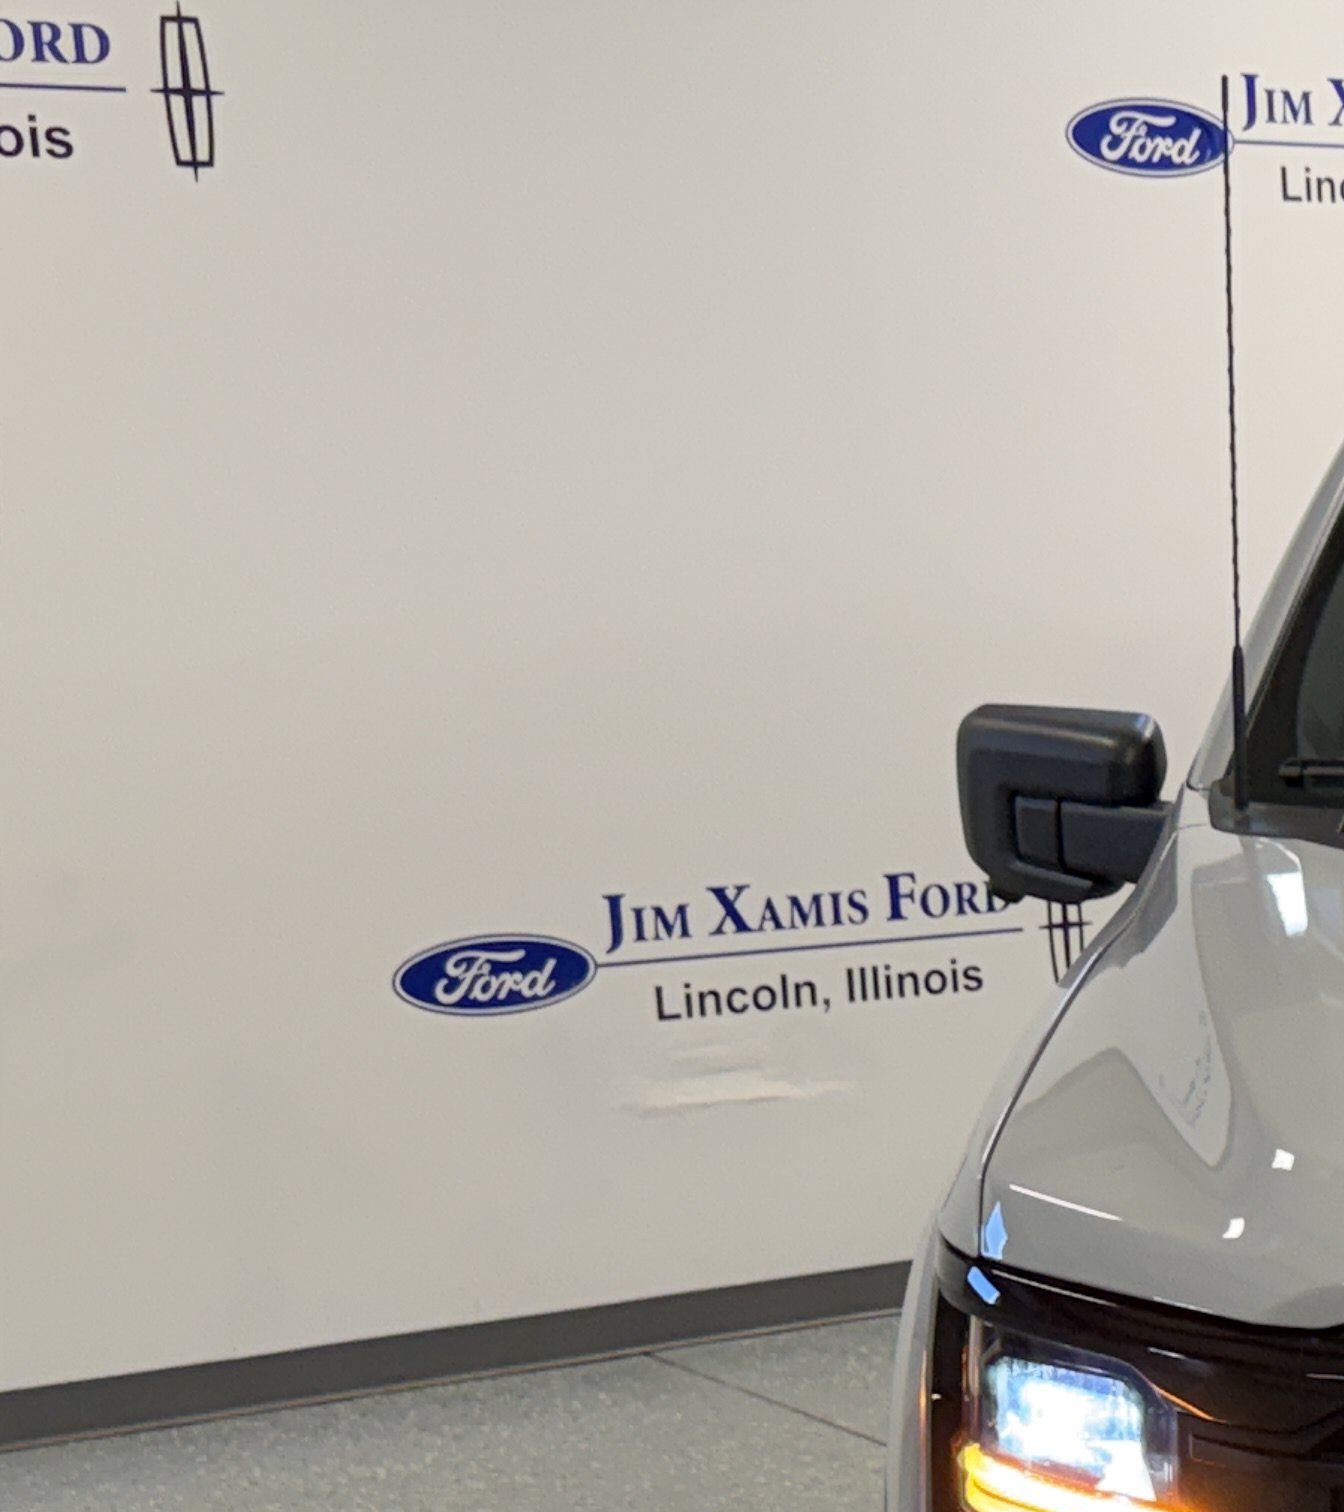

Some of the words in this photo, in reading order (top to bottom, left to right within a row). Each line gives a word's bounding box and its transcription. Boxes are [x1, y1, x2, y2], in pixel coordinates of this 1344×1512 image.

[1240, 72, 1313, 131] JIM
[1099, 110, 1202, 166] Ford
[602, 893, 692, 955] JIM
[706, 884, 870, 937] XAMIS
[433, 945, 558, 1005] Ford
[654, 973, 831, 1022] Lincoln,
[846, 958, 985, 1003] Illinois
